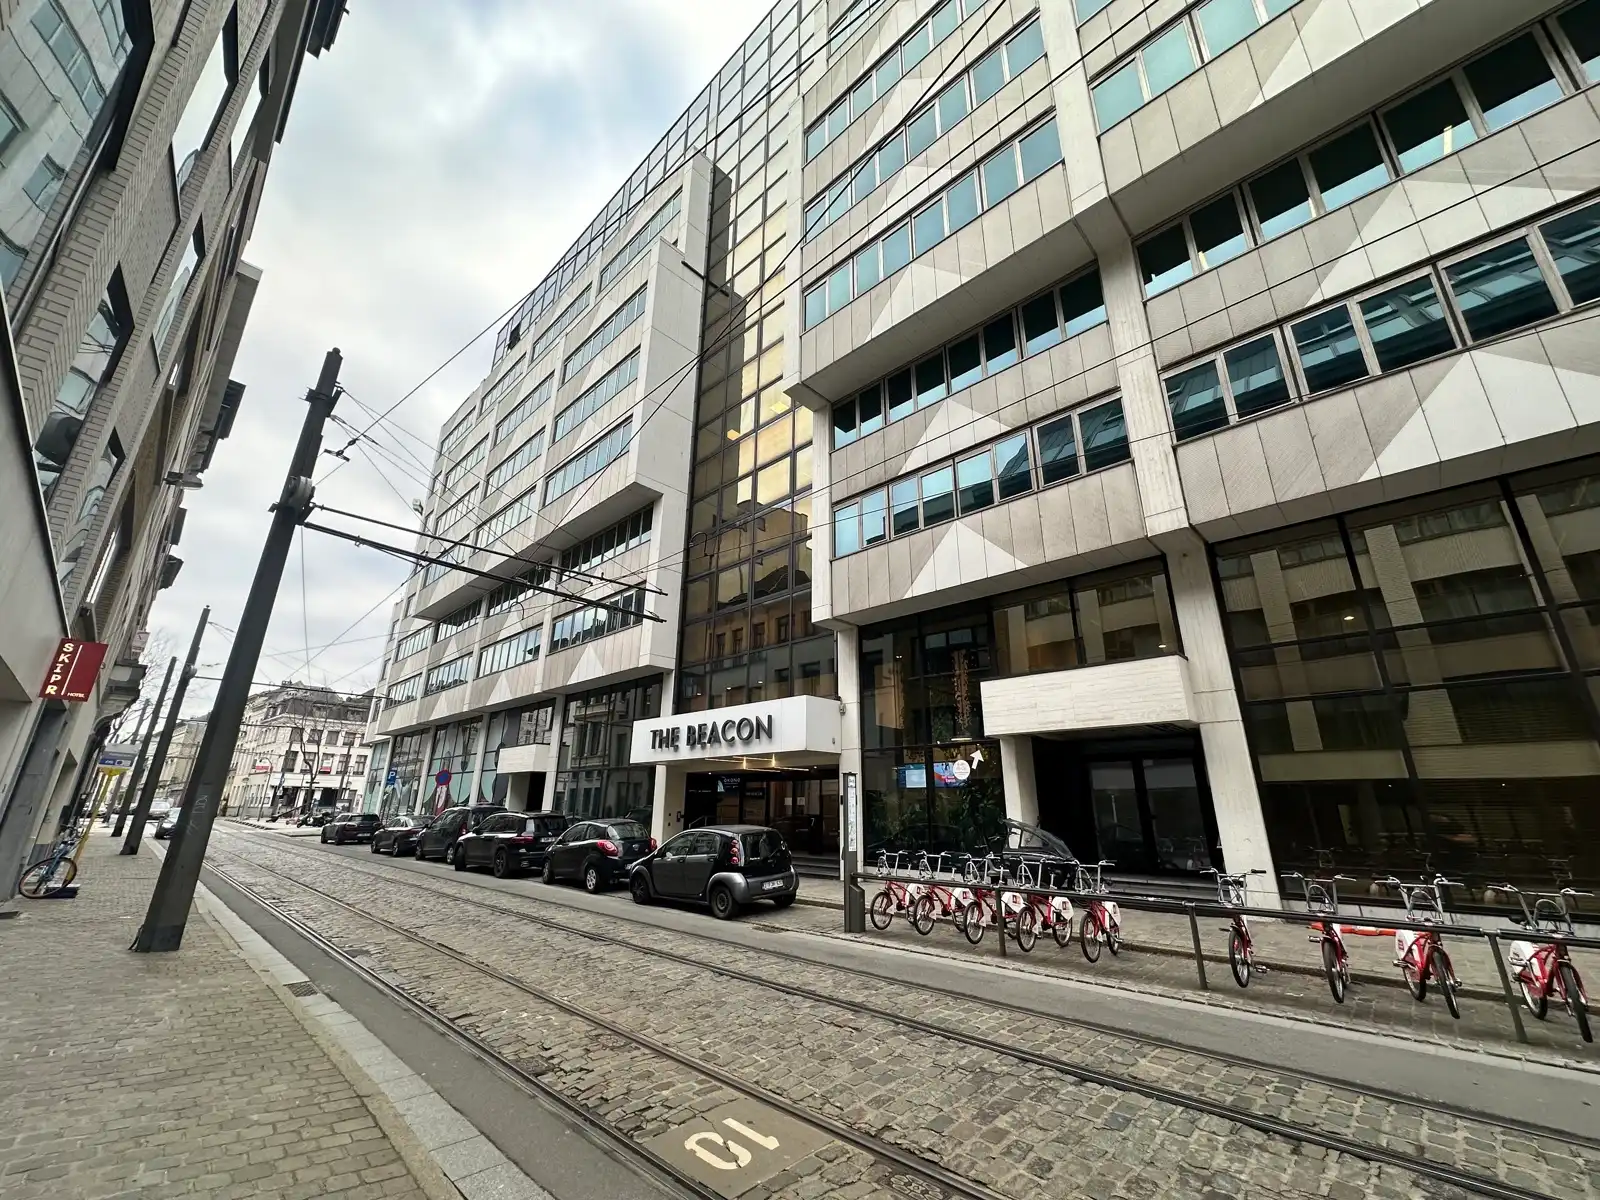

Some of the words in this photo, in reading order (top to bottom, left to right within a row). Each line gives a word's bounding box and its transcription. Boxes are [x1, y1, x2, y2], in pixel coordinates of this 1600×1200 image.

[45, 643, 75, 695] SKIPR
[650, 727, 680, 750] THE
[686, 715, 773, 746] BEACON
[388, 771, 396, 779] P
